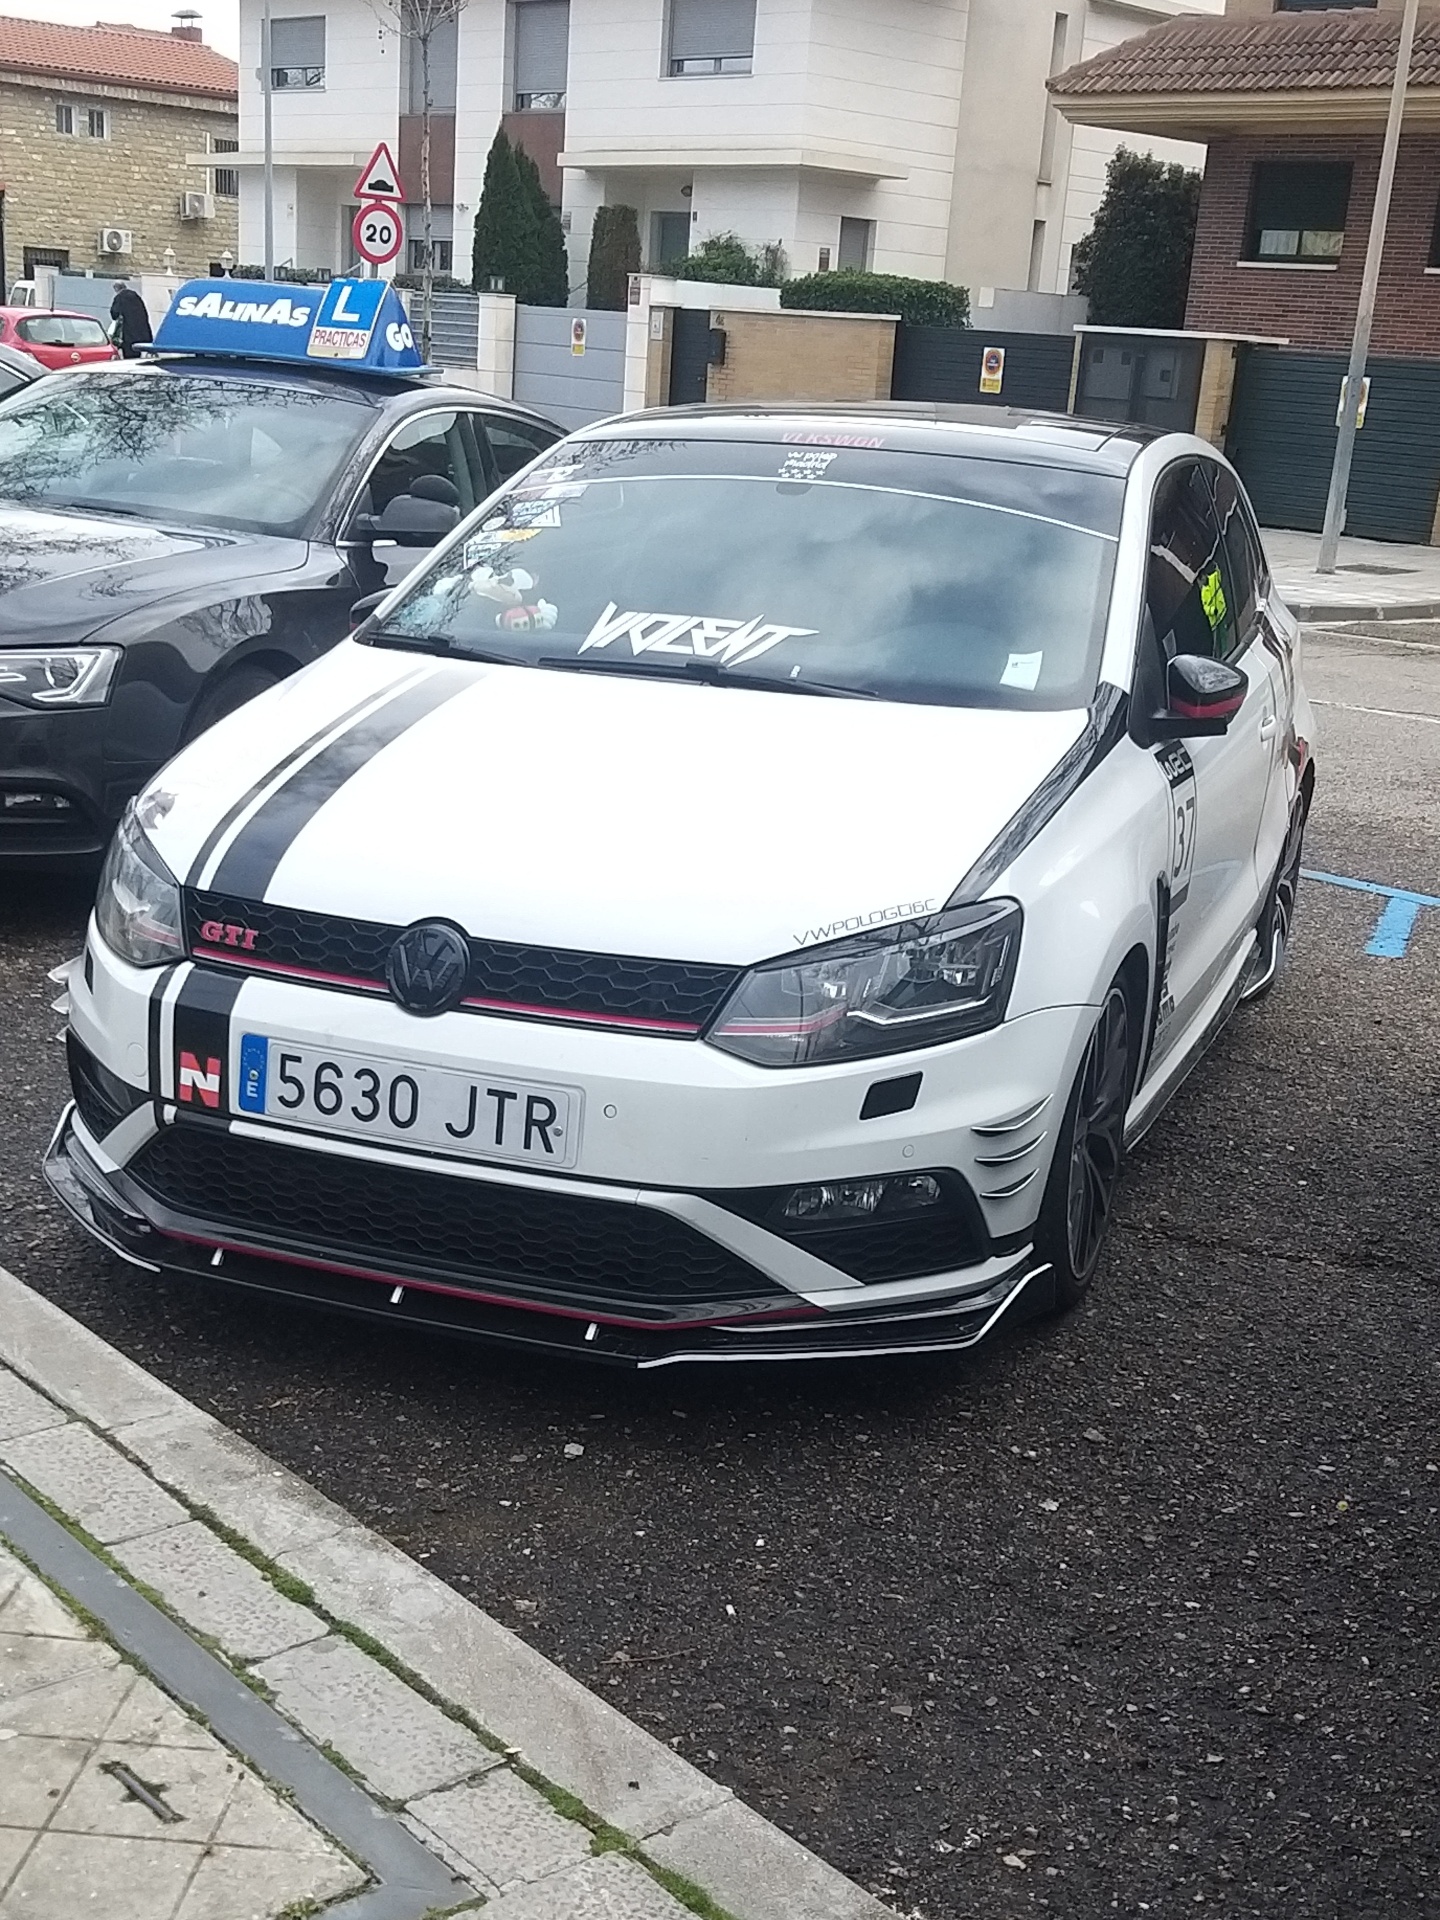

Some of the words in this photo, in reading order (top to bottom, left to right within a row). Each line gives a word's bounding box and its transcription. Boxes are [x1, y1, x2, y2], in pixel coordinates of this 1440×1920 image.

[365, 223, 392, 245] 20
[175, 292, 312, 328] SALINAS
[331, 286, 360, 322] L
[313, 328, 368, 349] PRACTICAS
[577, 600, 821, 669] VIOLENT
[1173, 796, 1196, 879] 37
[201, 920, 260, 950] GTI
[276, 1053, 421, 1130] 5630
[444, 1085, 558, 1154] JTR
